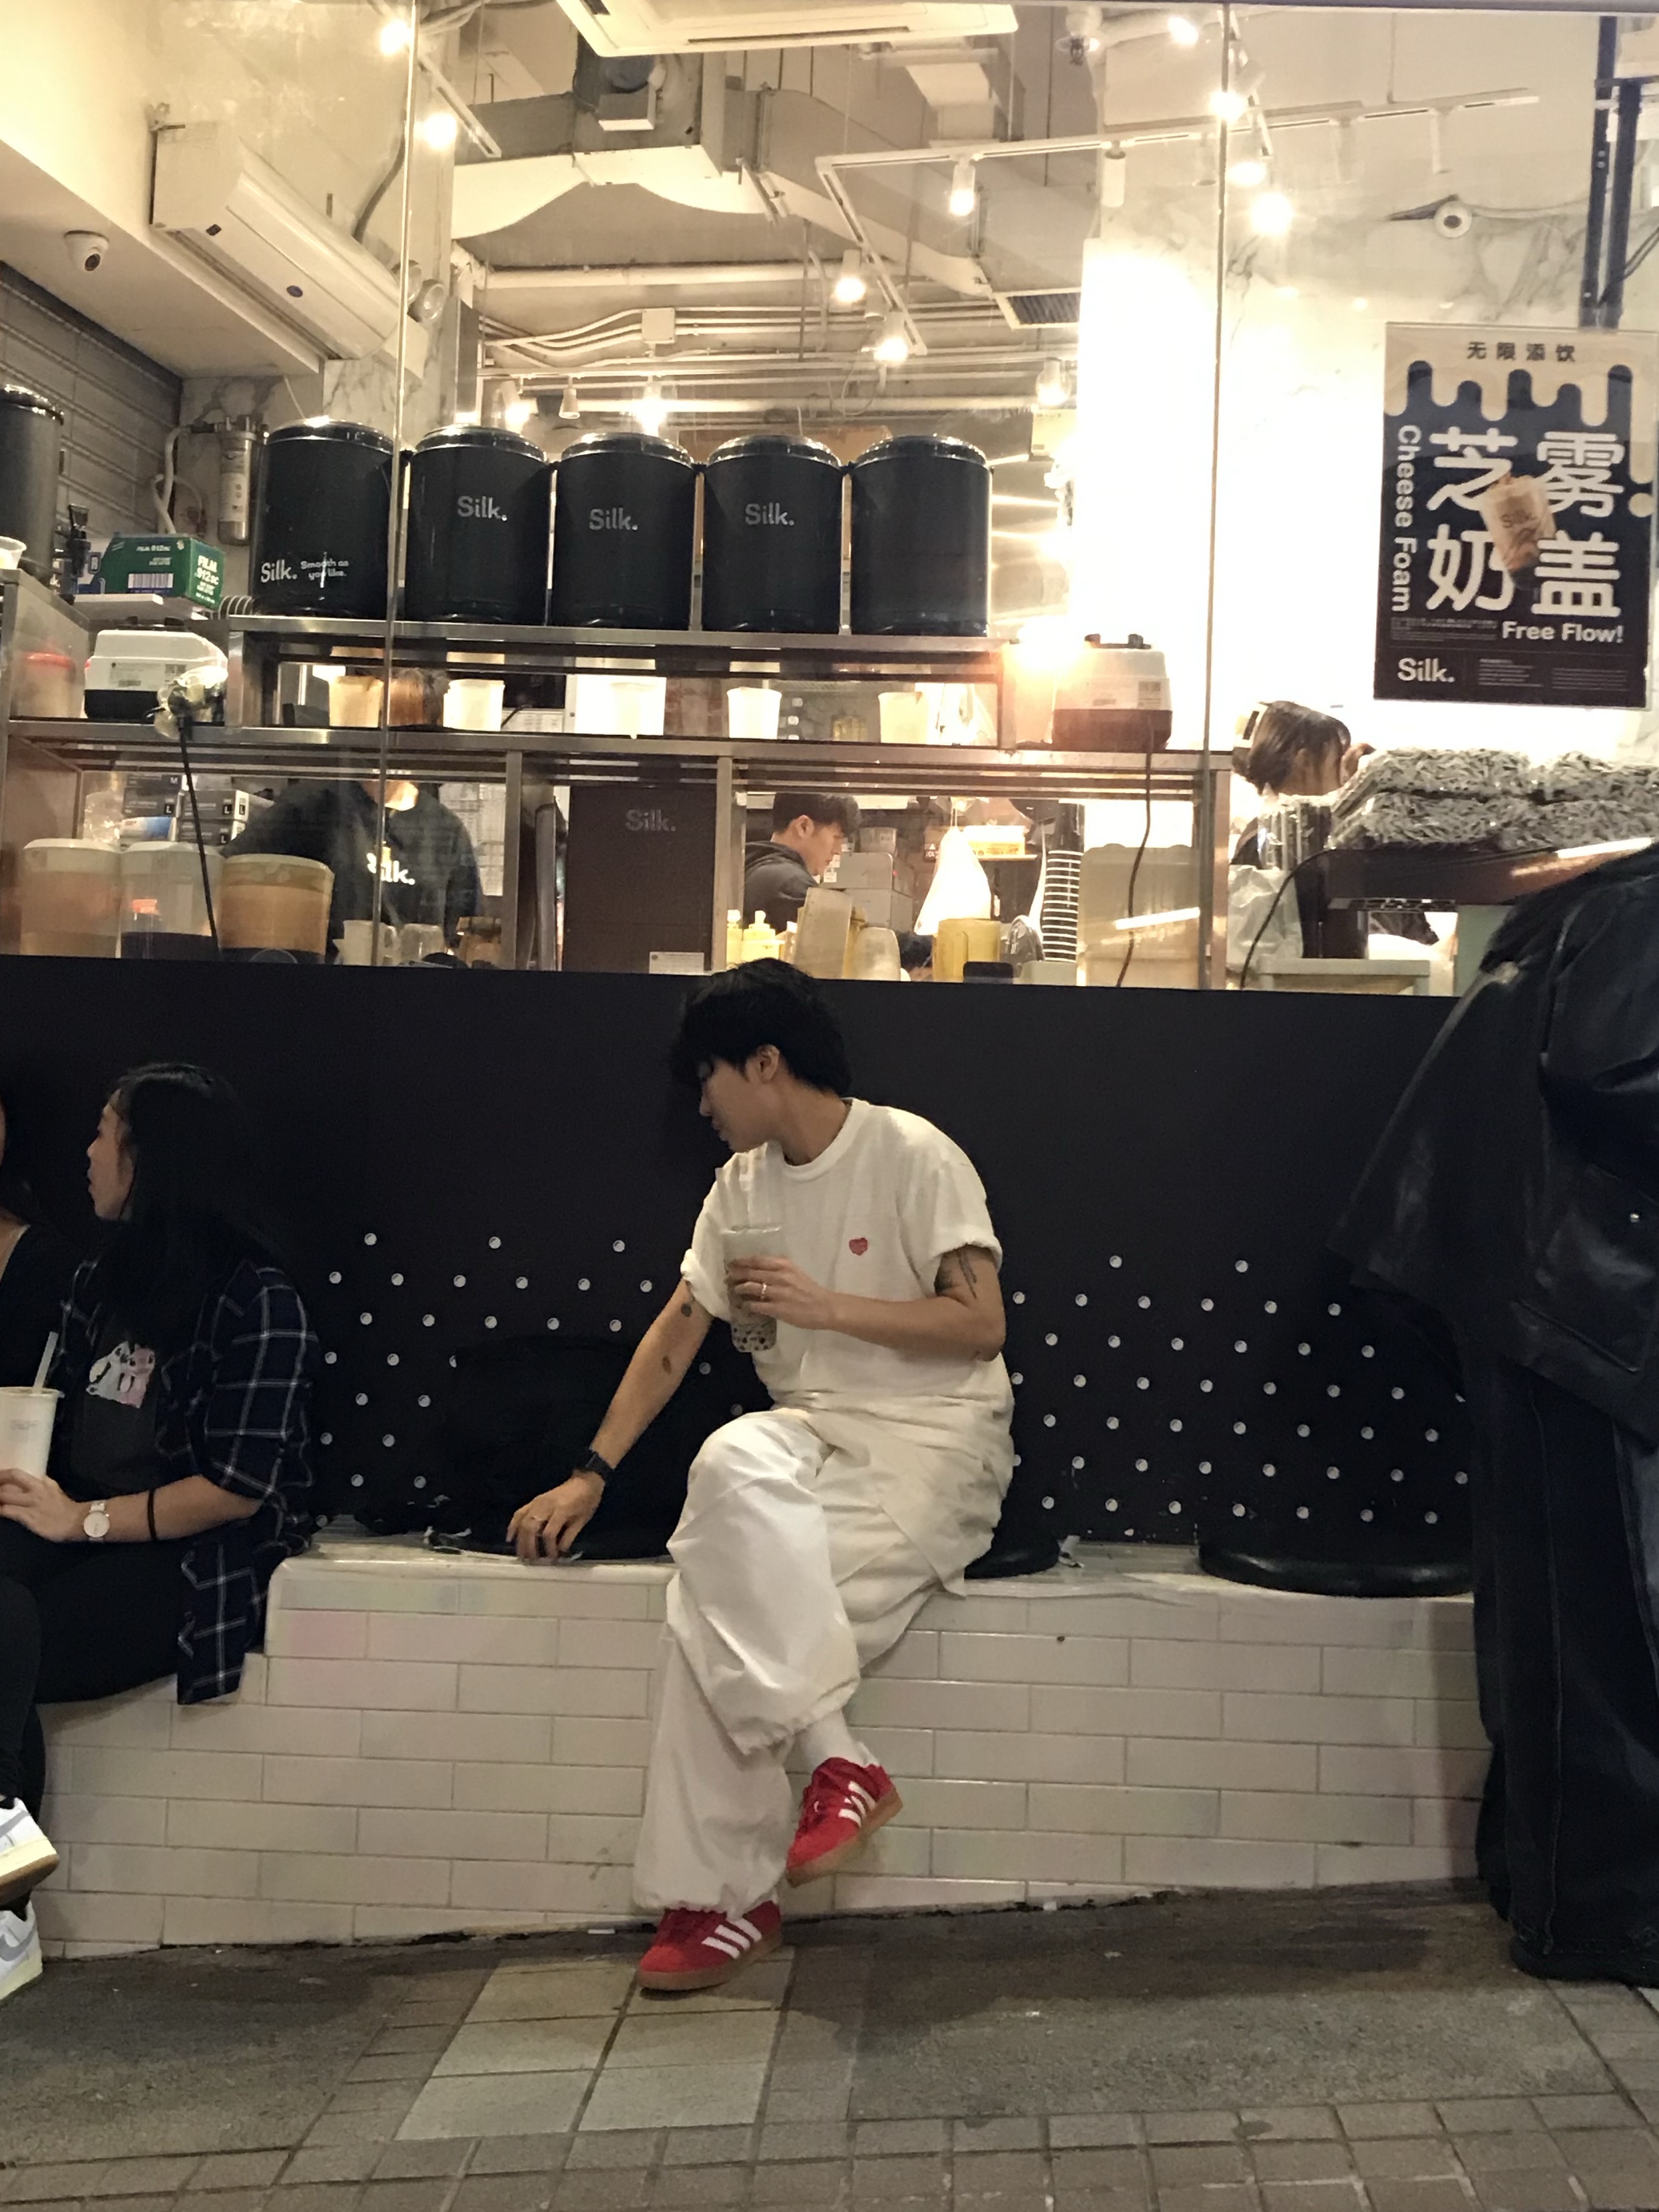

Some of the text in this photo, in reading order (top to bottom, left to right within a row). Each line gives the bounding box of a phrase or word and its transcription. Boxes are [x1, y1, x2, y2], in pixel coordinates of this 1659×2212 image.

[1427, 426, 1626, 517] 芝雾
[457, 495, 507, 521] Silk.
[589, 507, 638, 531] Silk.
[746, 502, 795, 526] Silk.
[1391, 425, 1422, 612] Cheese Foam
[261, 559, 298, 583] Silk.
[1426, 524, 1621, 617] 奶盖
[1503, 621, 1554, 640] Free
[1562, 623, 1624, 644] Flow!
[1397, 657, 1455, 683] Silk.
[166, 806, 172, 814] L
[224, 806, 230, 814] L
[626, 809, 677, 832] Silk.
